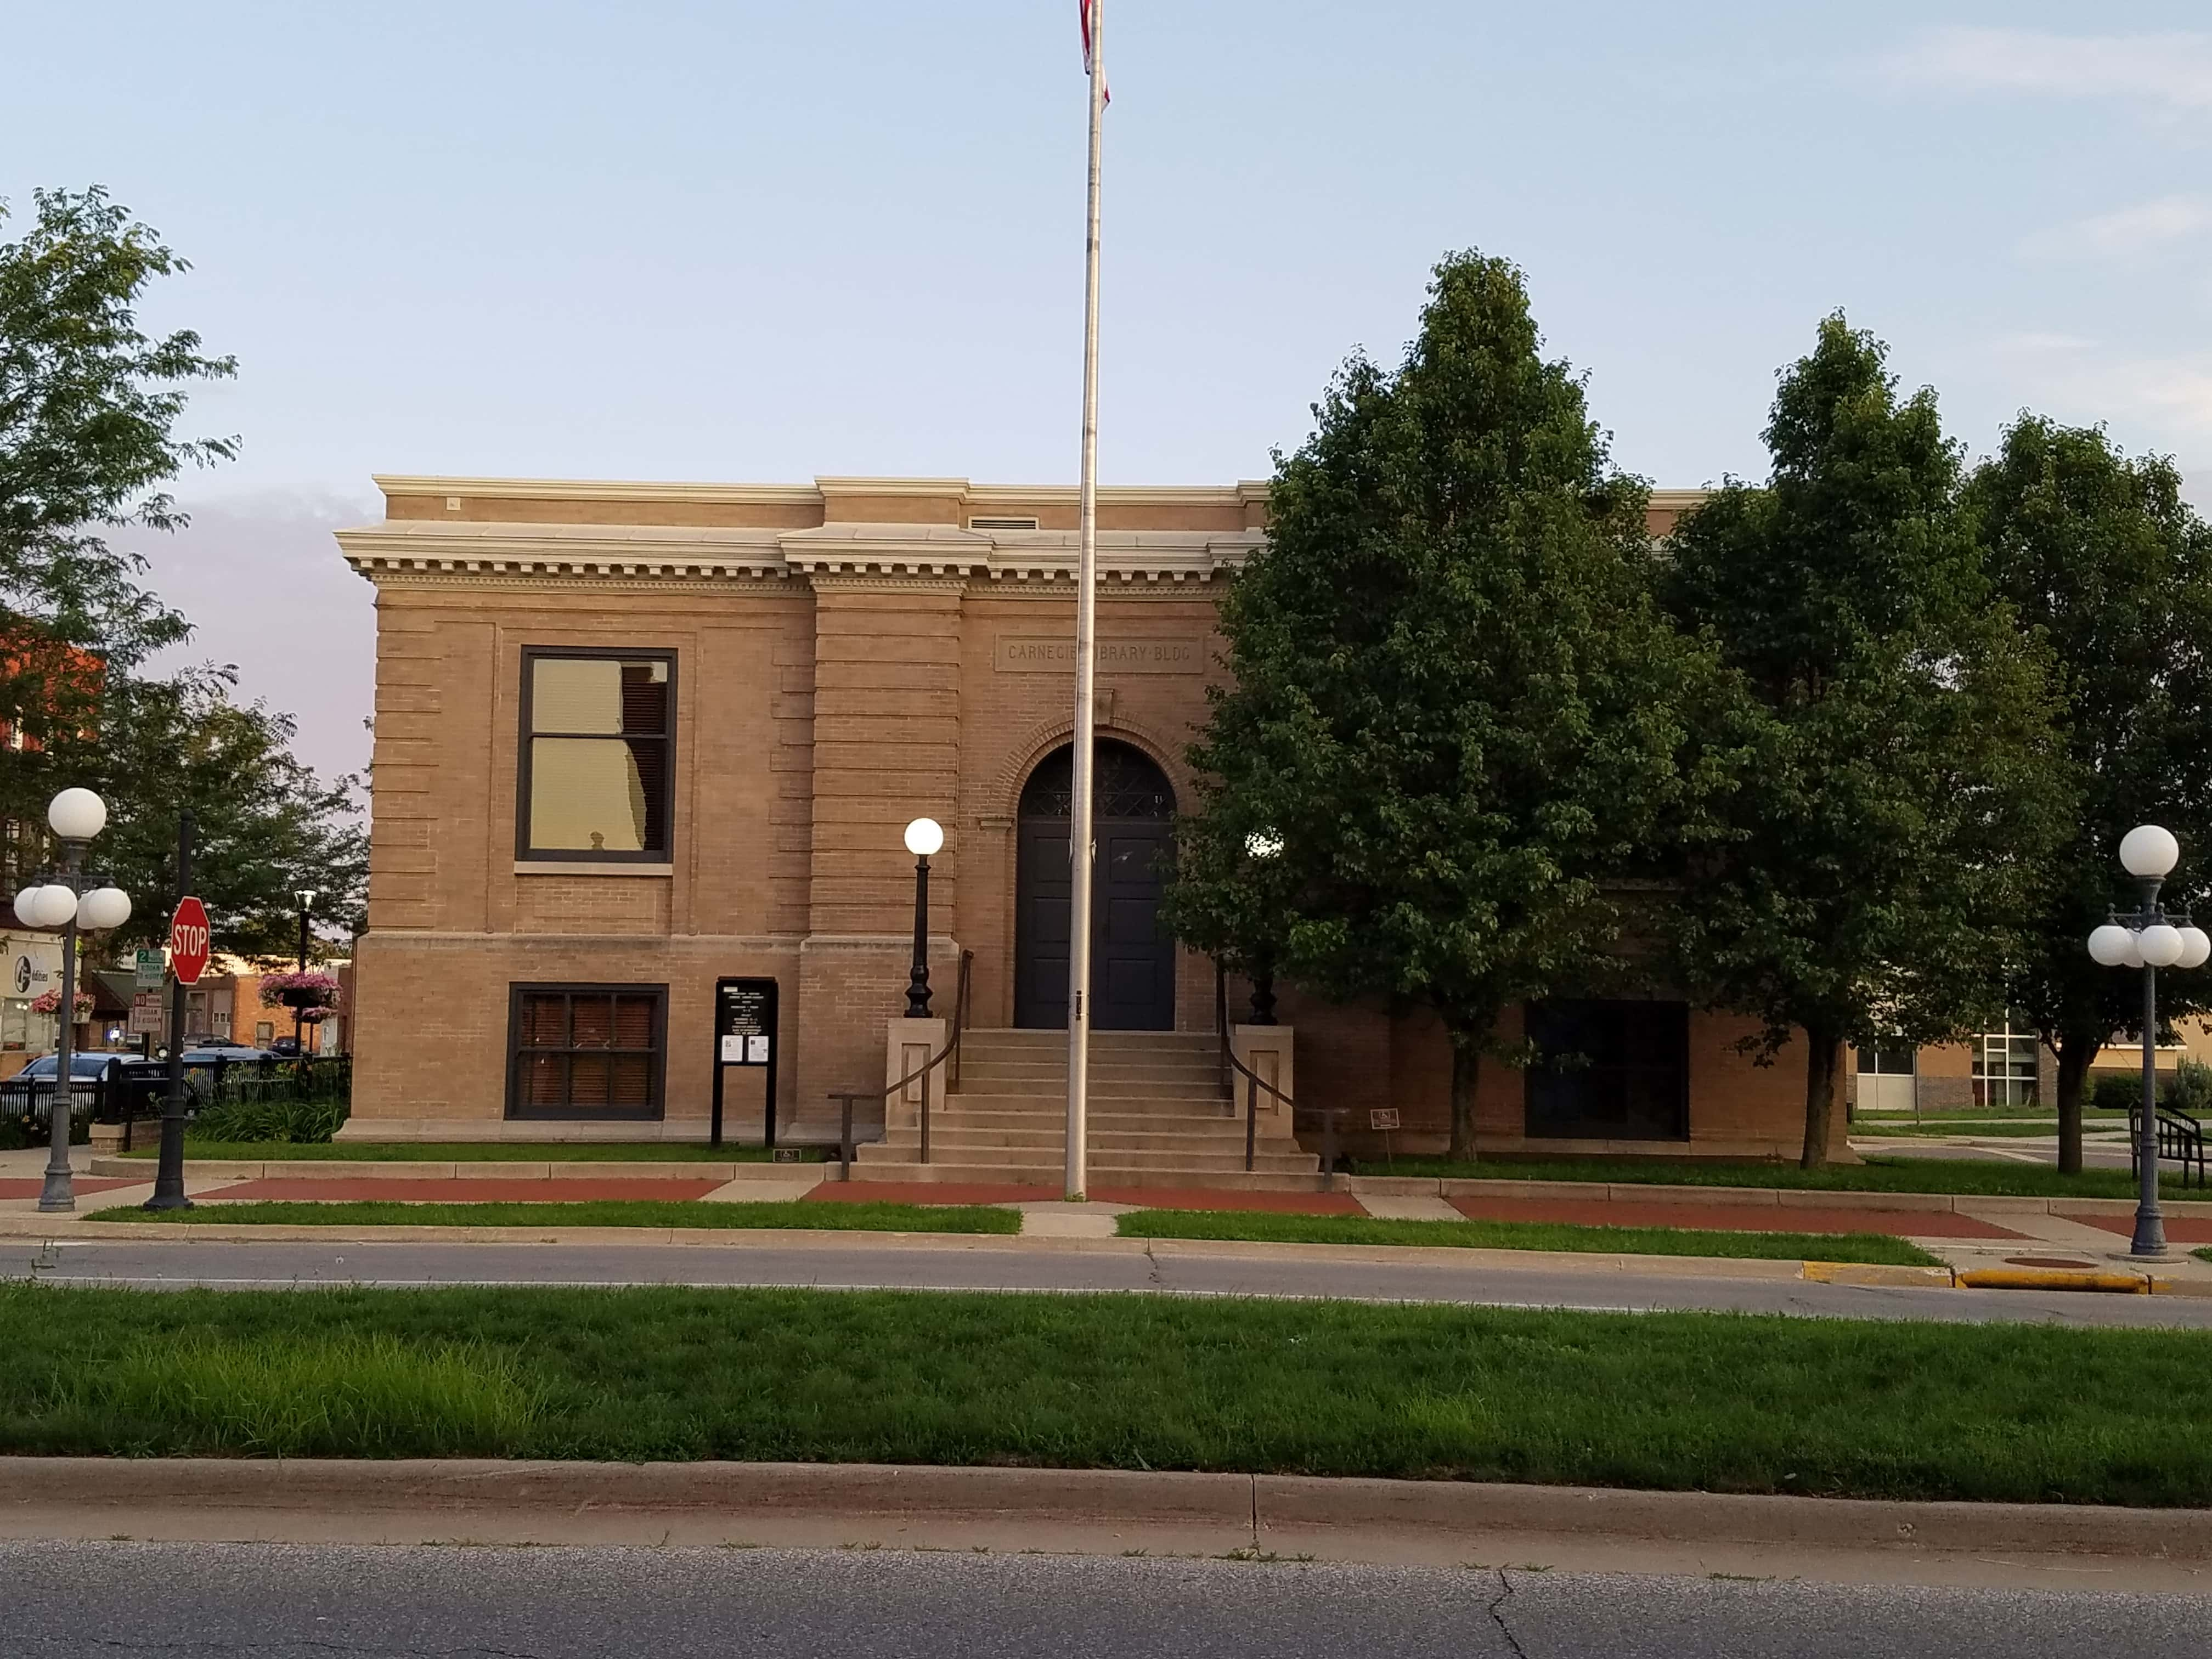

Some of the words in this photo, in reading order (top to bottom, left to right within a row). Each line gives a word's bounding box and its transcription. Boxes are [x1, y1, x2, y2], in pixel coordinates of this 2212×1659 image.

[1095, 646, 1147, 661] IBRARY
[1154, 646, 1190, 662] BLDG
[173, 923, 207, 957] STOP
[140, 951, 146, 962] 2
[136, 995, 145, 1005] NO
